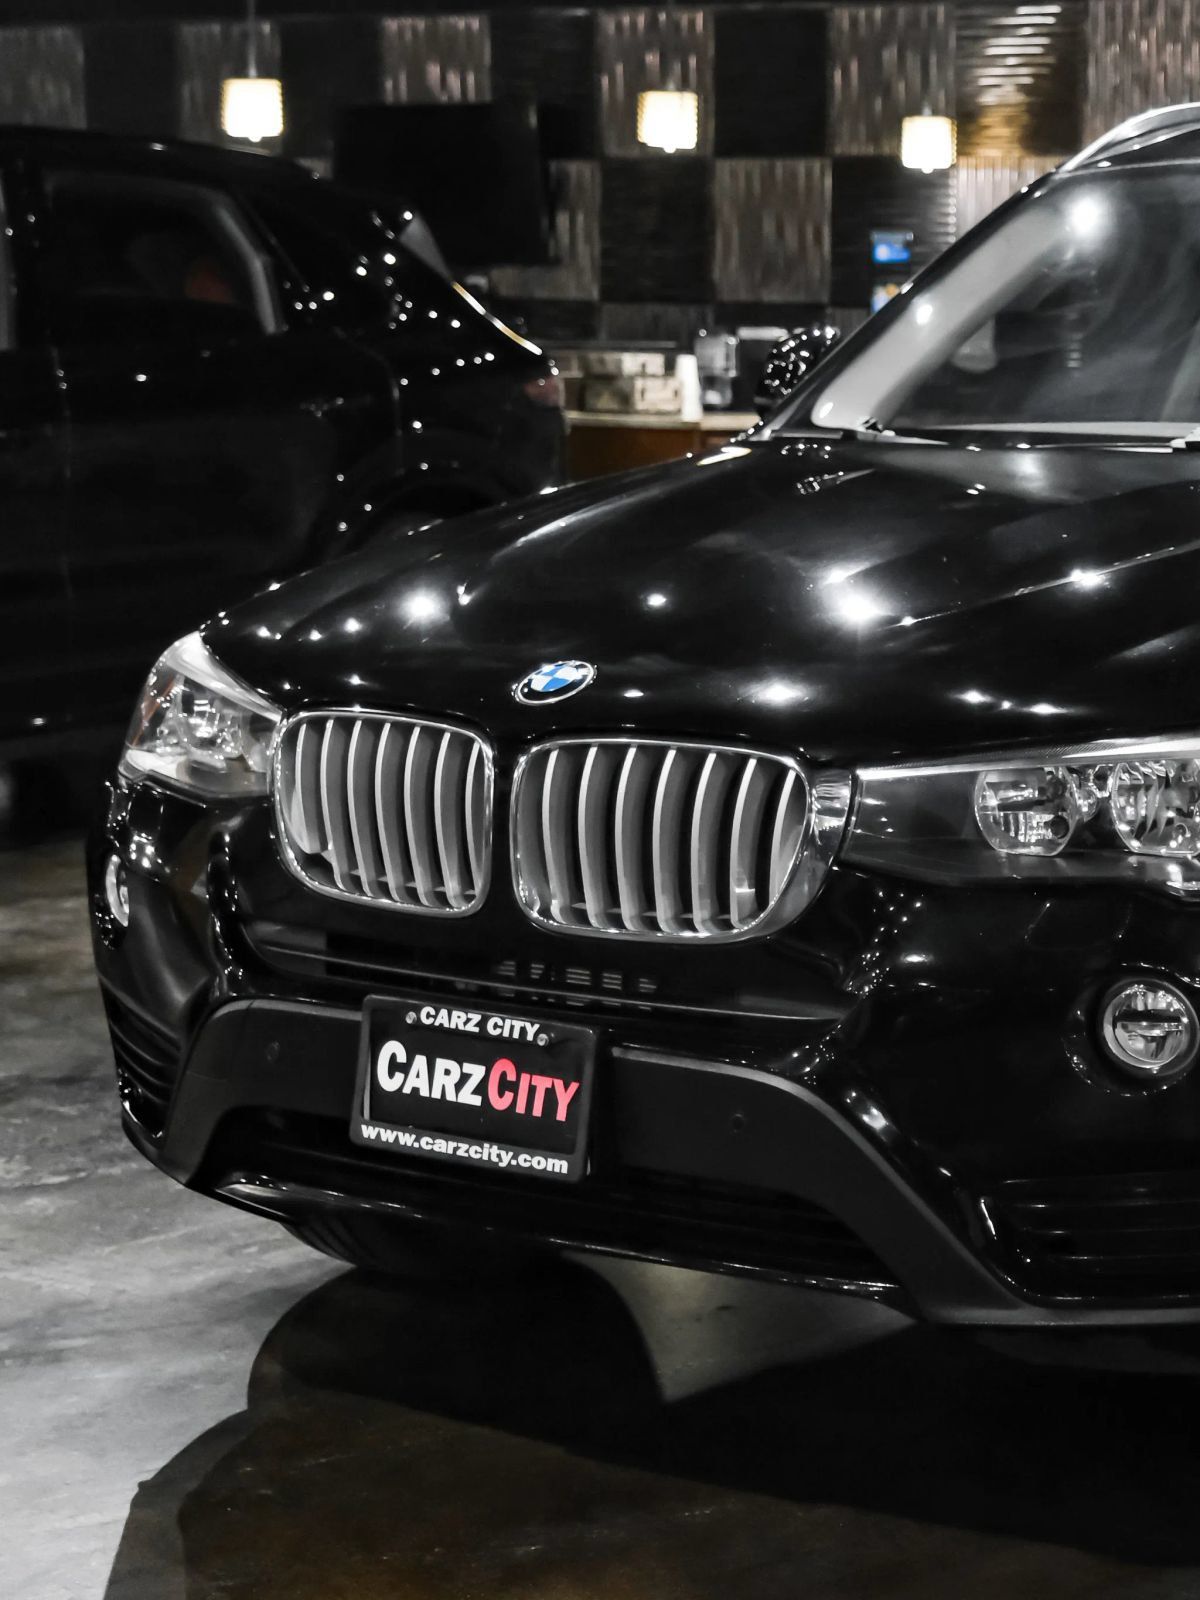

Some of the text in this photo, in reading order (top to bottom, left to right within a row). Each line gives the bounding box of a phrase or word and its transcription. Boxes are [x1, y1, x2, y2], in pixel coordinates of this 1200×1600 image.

[420, 1006, 540, 1042] CARZ CITY
[361, 1124, 568, 1174] www.carzcity.com
